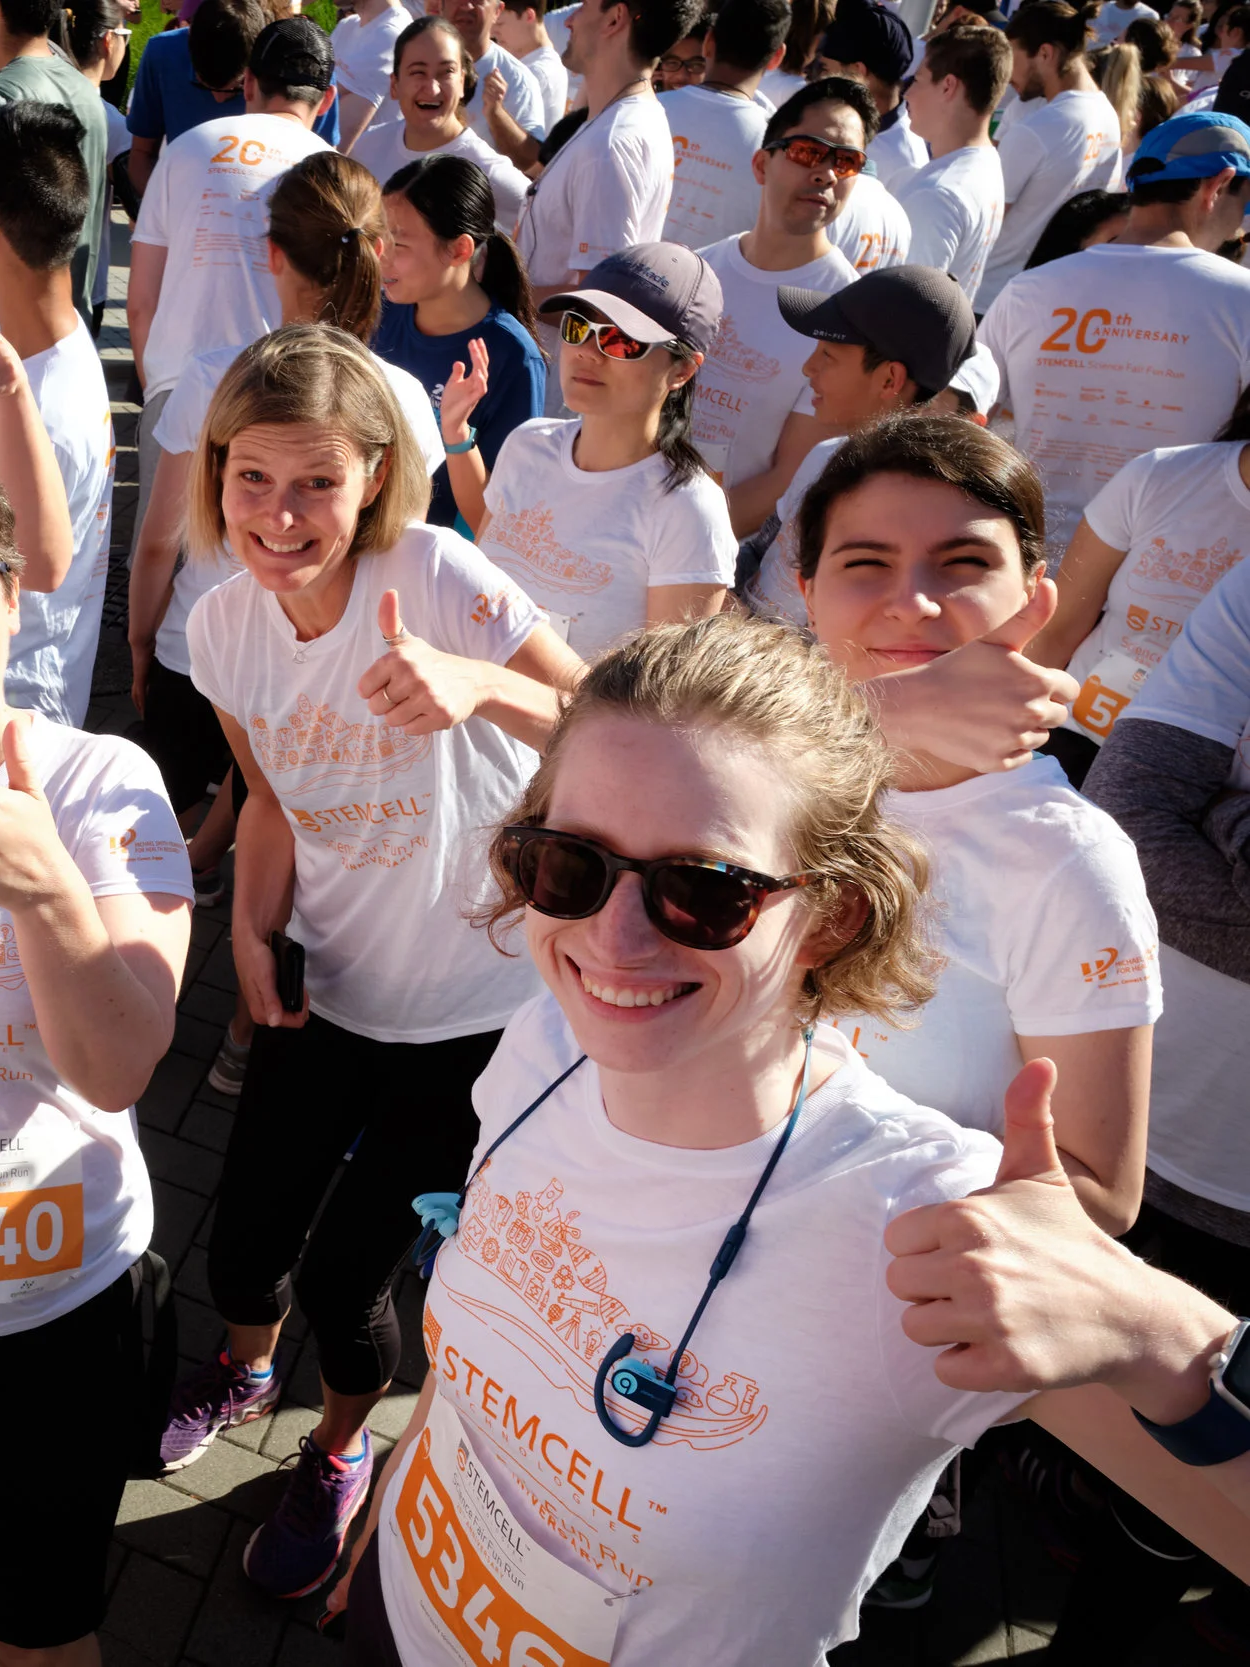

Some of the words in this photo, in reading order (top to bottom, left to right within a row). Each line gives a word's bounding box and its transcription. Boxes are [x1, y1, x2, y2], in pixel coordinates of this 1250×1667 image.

[1093, 327, 1191, 346] ANNIVERSARY
[1036, 356, 1085, 369] STEMCELL
[1087, 359, 1124, 372] Science
[1126, 361, 1144, 374] Fair
[1145, 365, 1164, 377] Fun
[1165, 368, 1186, 380] Run
[696, 384, 743, 413] MCELL
[313, 797, 427, 825] STEMCELL
[10, 1167, 29, 1178] Run
[442, 1345, 642, 1532] STEMCELL
[443, 1373, 641, 1544] TECHNOLOGIES
[467, 1461, 524, 1557] STEMCELL
[472, 1515, 487, 1542] Fair
[486, 1539, 503, 1570] Fun
[503, 1563, 525, 1591] Run
[598, 1542, 654, 1588] Run
